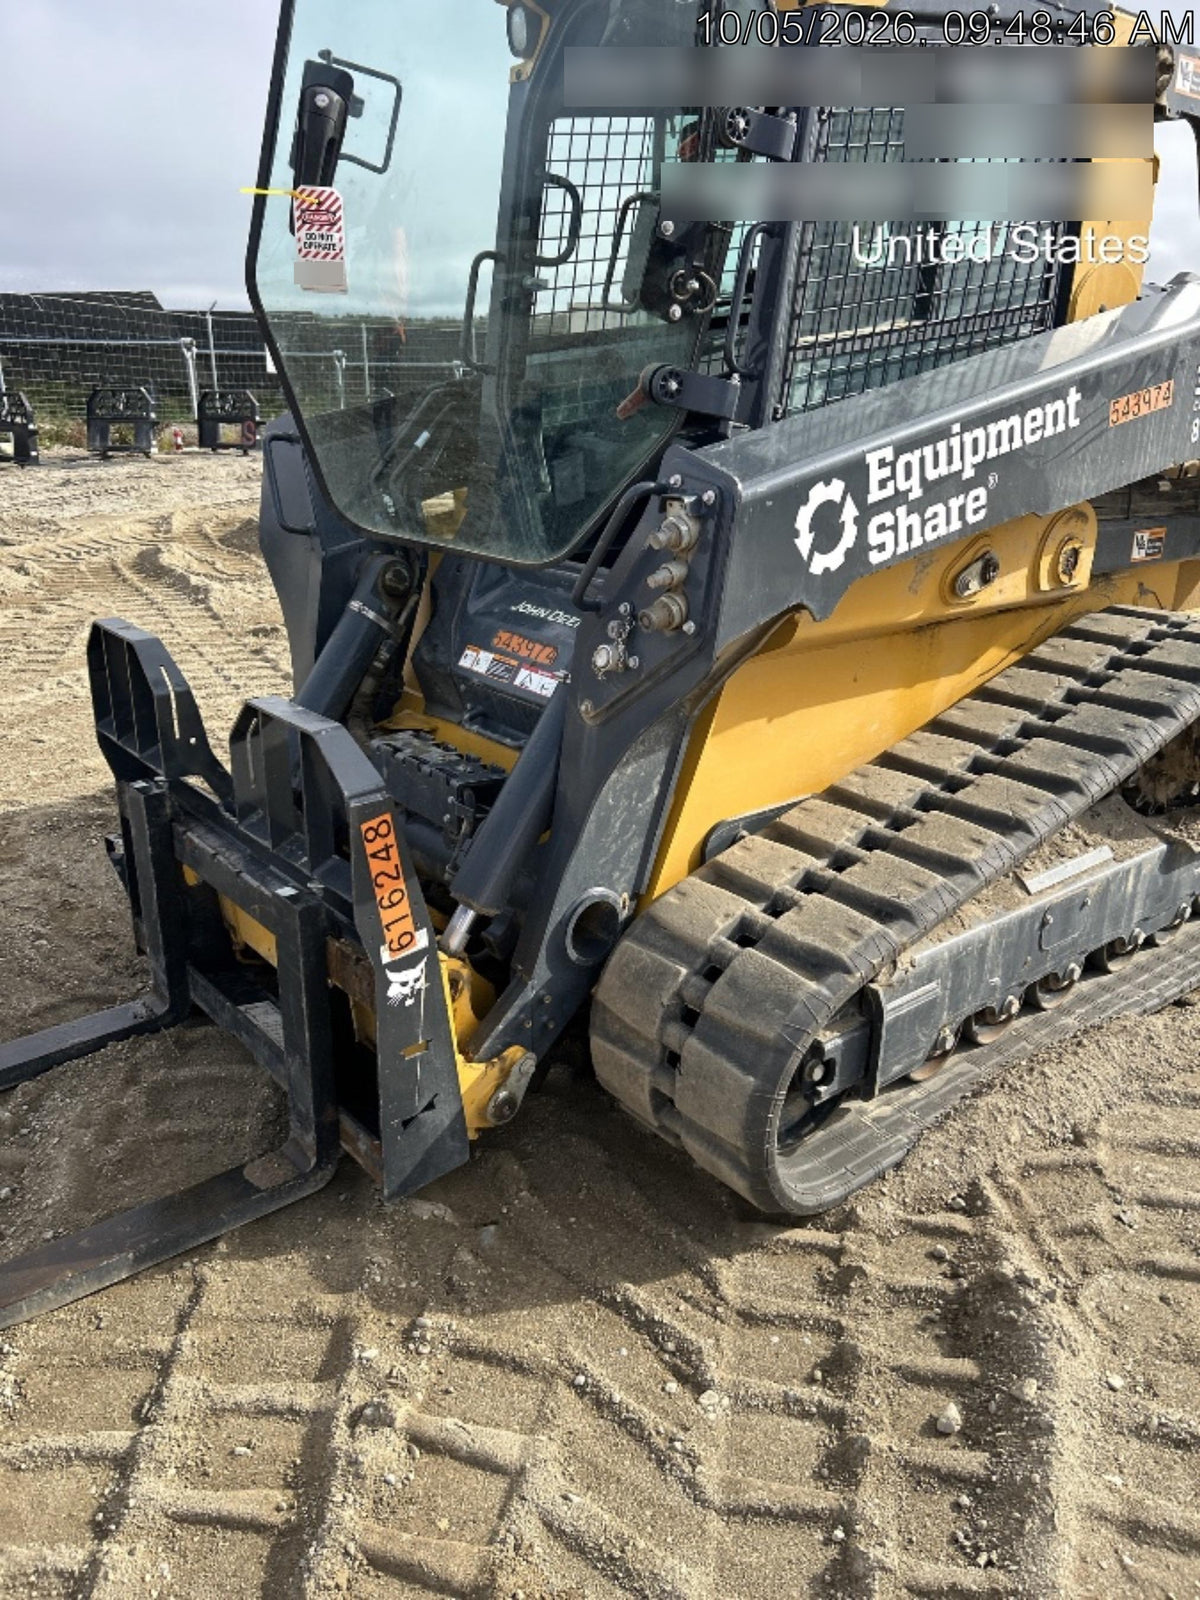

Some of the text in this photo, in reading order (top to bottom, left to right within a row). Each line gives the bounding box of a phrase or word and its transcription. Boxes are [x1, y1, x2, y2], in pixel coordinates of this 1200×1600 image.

[303, 242, 336, 251] OPERATE
[305, 233, 334, 241] DO NOT
[1110, 383, 1172, 424] 543974
[865, 386, 1082, 504] Equipment
[511, 601, 549, 618] JOHN
[363, 818, 415, 954] 616248
